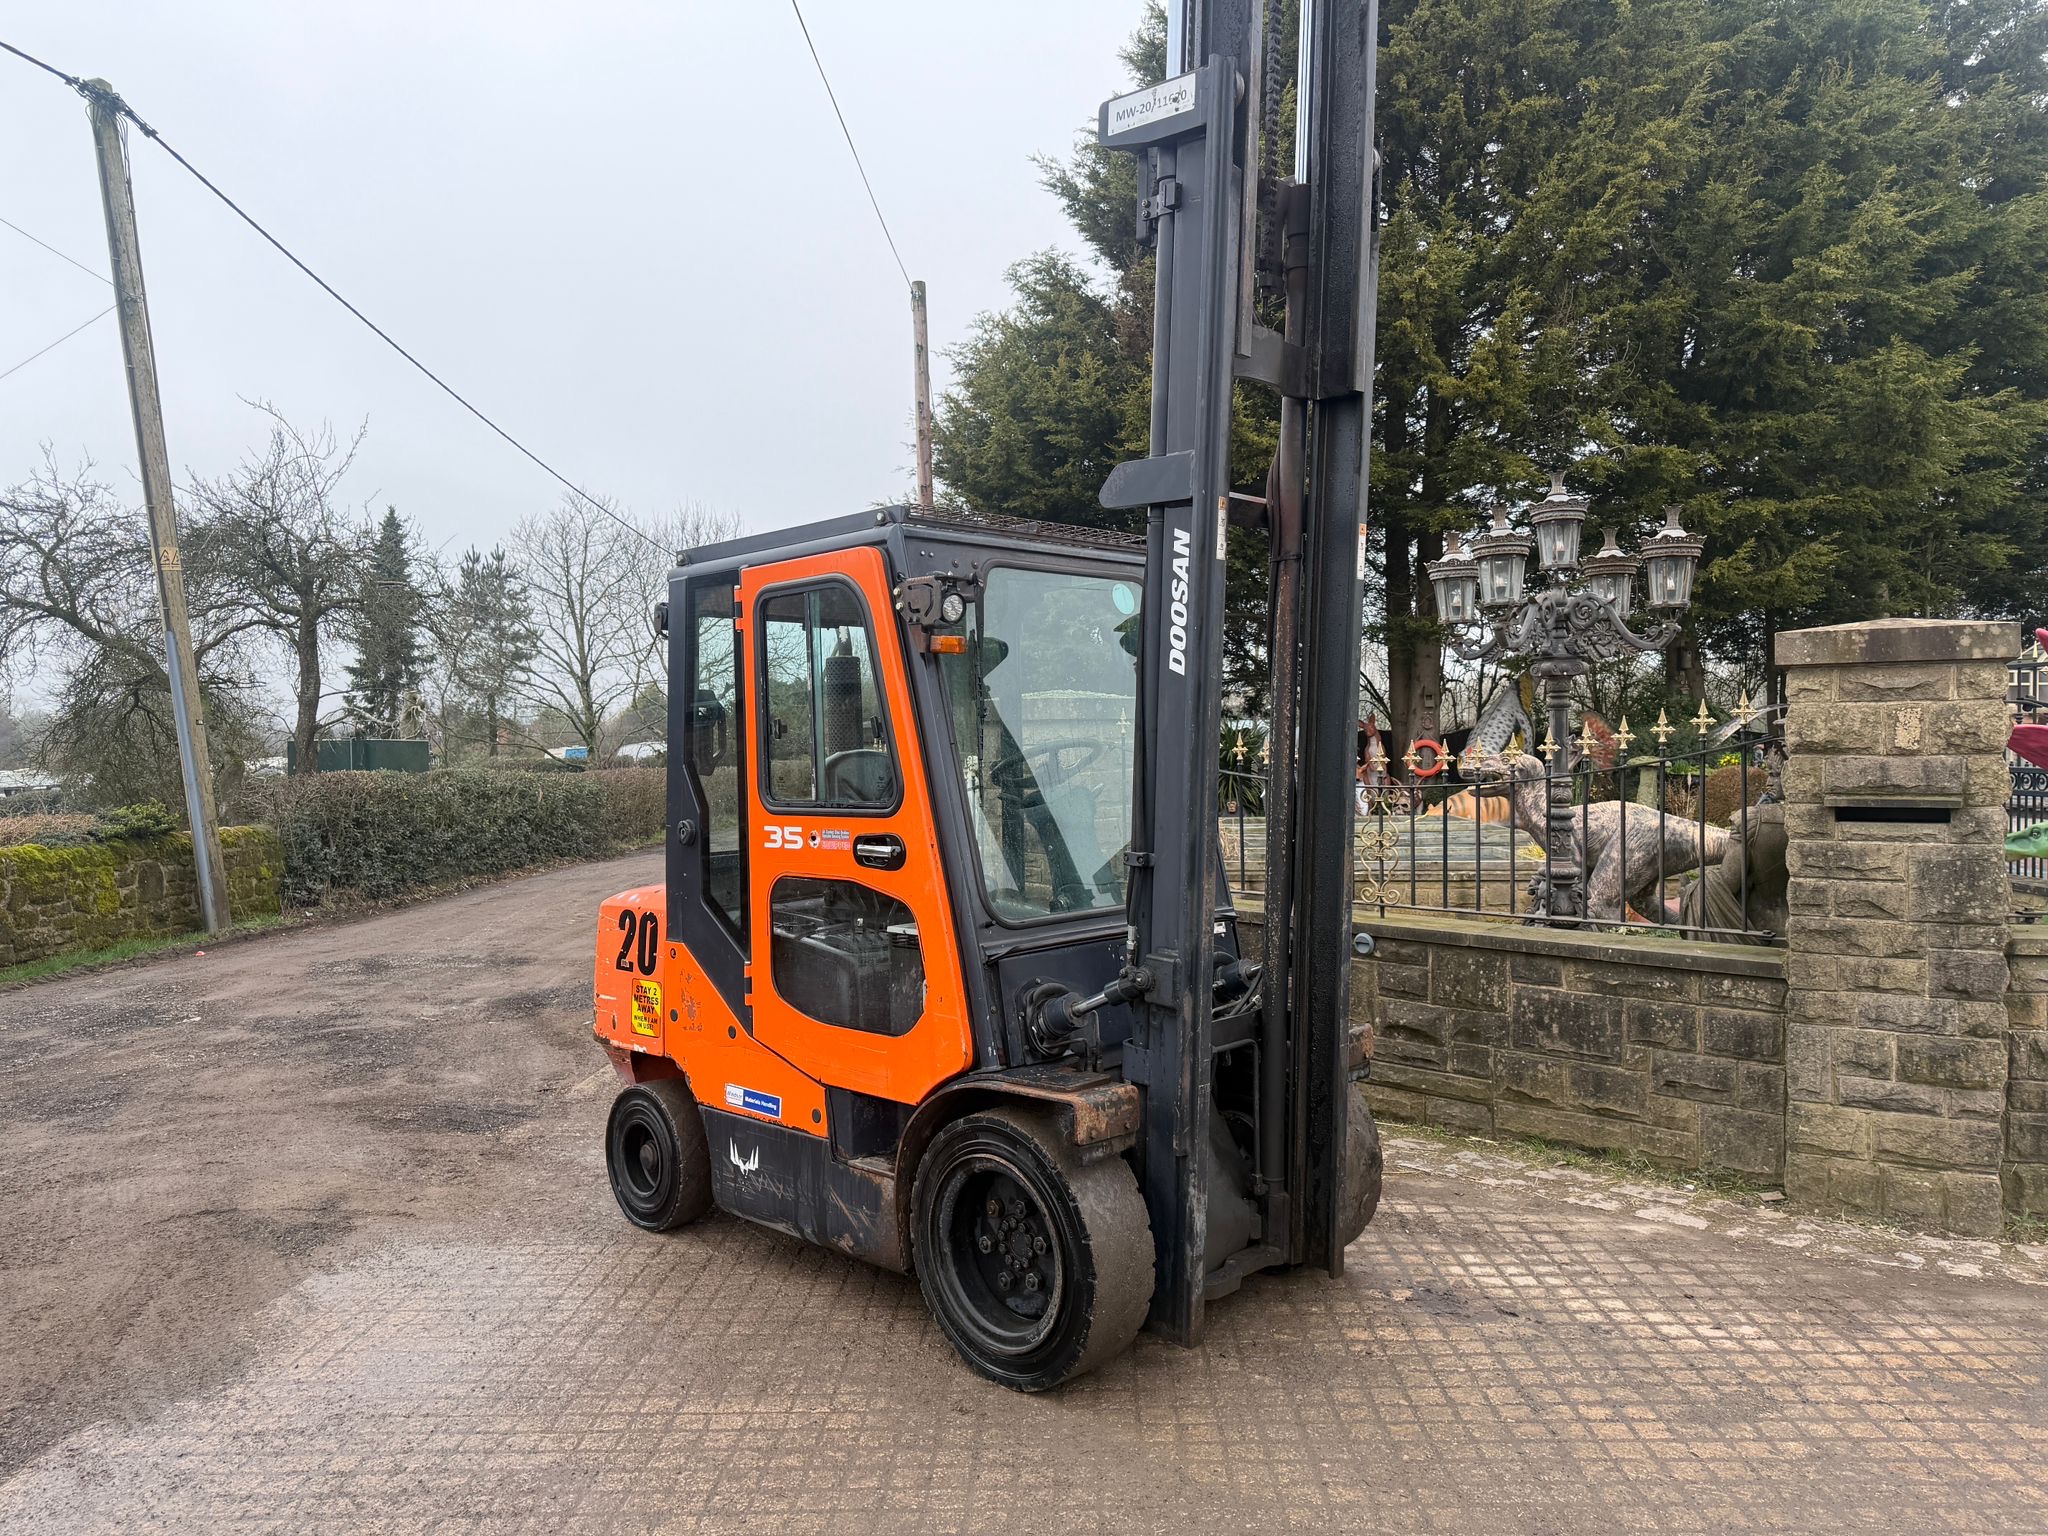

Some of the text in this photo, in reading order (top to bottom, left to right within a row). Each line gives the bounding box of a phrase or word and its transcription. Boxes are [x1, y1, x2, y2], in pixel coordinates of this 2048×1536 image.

[1168, 527, 1191, 676] DOOSAN
[763, 825, 804, 850] 35
[616, 909, 659, 976] 20
[633, 993, 659, 1006] METRES
[635, 984, 658, 996] STAY 2
[637, 1003, 655, 1015] AWAY
